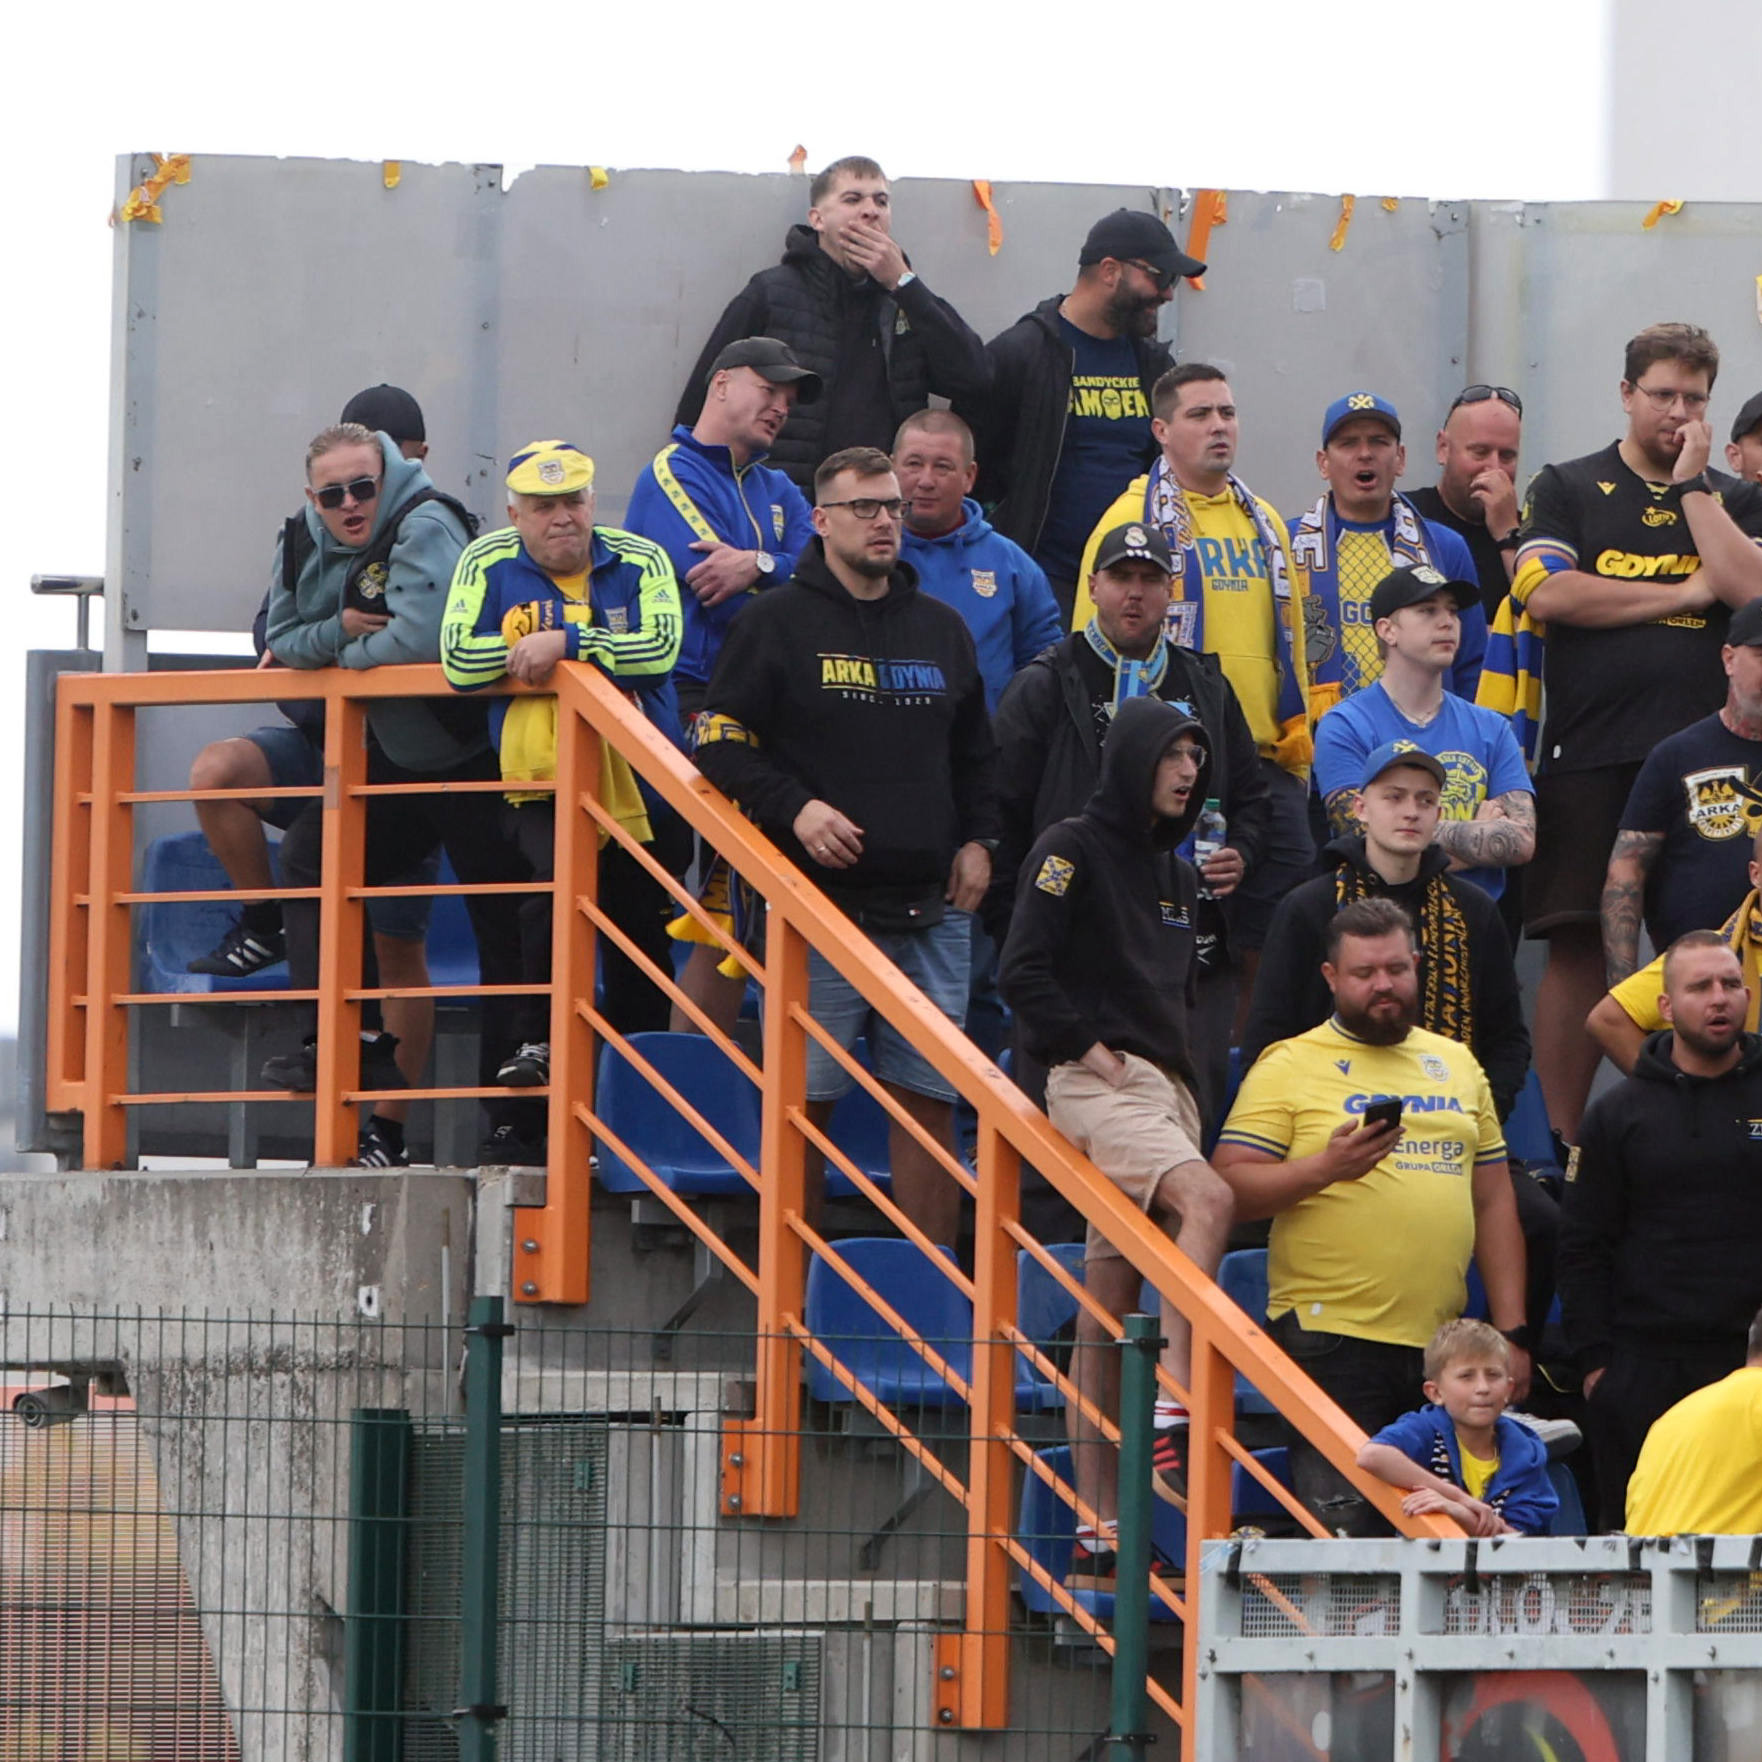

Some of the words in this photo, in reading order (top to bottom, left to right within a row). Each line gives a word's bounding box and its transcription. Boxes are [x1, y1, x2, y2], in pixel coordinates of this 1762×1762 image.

[1596, 548, 1701, 578] GDYNI
[822, 659, 876, 686] ARKA
[1696, 803, 1741, 818] ARKA
[1395, 1137, 1464, 1160] Energa
